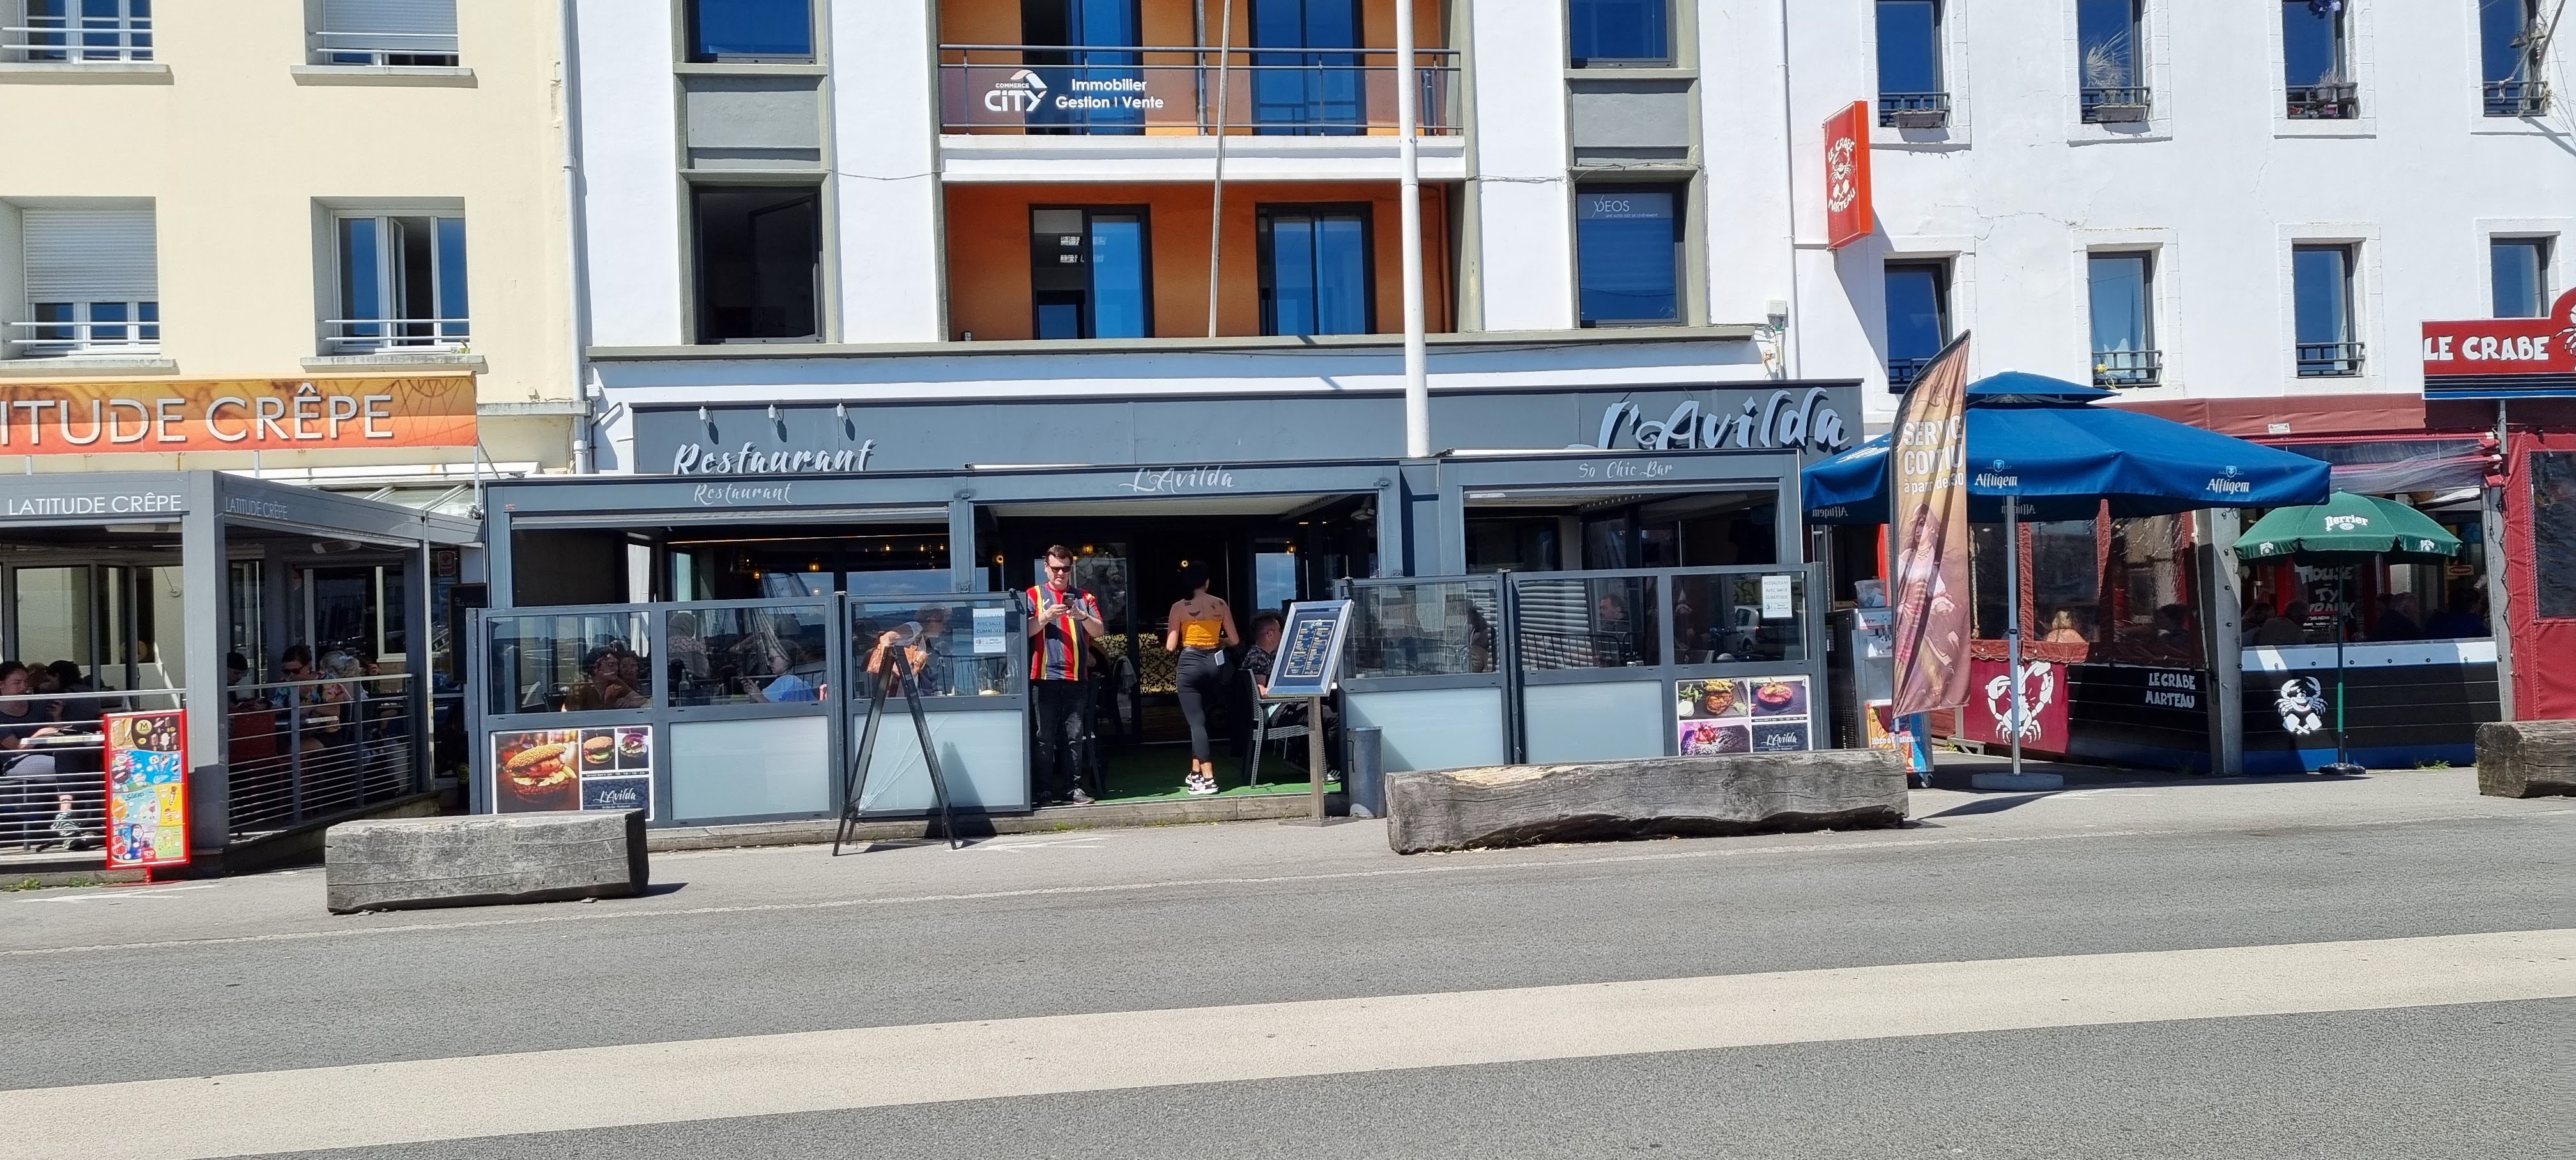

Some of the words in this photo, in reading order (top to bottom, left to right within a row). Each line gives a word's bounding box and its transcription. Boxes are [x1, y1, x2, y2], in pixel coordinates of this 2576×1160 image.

[1071, 78, 1147, 91] Immobilier
[1055, 96, 1110, 109] Gestion
[1121, 96, 1165, 109] Vente
[1828, 146, 1836, 163] LE
[1835, 137, 1856, 152] CRABE
[1828, 187, 1857, 213] MARTEAU
[2423, 335, 2454, 361] LE
[2462, 335, 2550, 362] CRABE
[205, 382, 394, 442] CRÊPE
[1563, 386, 1850, 449] L'Avilda
[673, 439, 874, 475] Restaurant
[1119, 465, 1235, 494] L'Avilda
[1579, 462, 1596, 478] So
[1607, 461, 1637, 479] Chic
[1639, 461, 1673, 478] Bar
[1904, 479, 1910, 493] à
[1936, 476, 1949, 490] de
[1974, 474, 2018, 489] Affligem
[2206, 478, 2250, 495] Affligem
[8, 496, 105, 515] LATITUDE
[111, 492, 182, 512] CRÊPE
[694, 482, 793, 506] Restaurant
[225, 496, 262, 518] LATITUDE
[263, 501, 288, 521] CRÊPE
[2324, 514, 2369, 531] Perrier
[2149, 672, 2161, 687] LE
[2161, 673, 2196, 691] CRABE
[2145, 690, 2195, 709] MARTEAU
[1761, 732, 1797, 747] L'Avilda
[593, 788, 636, 805] L'Avilda
